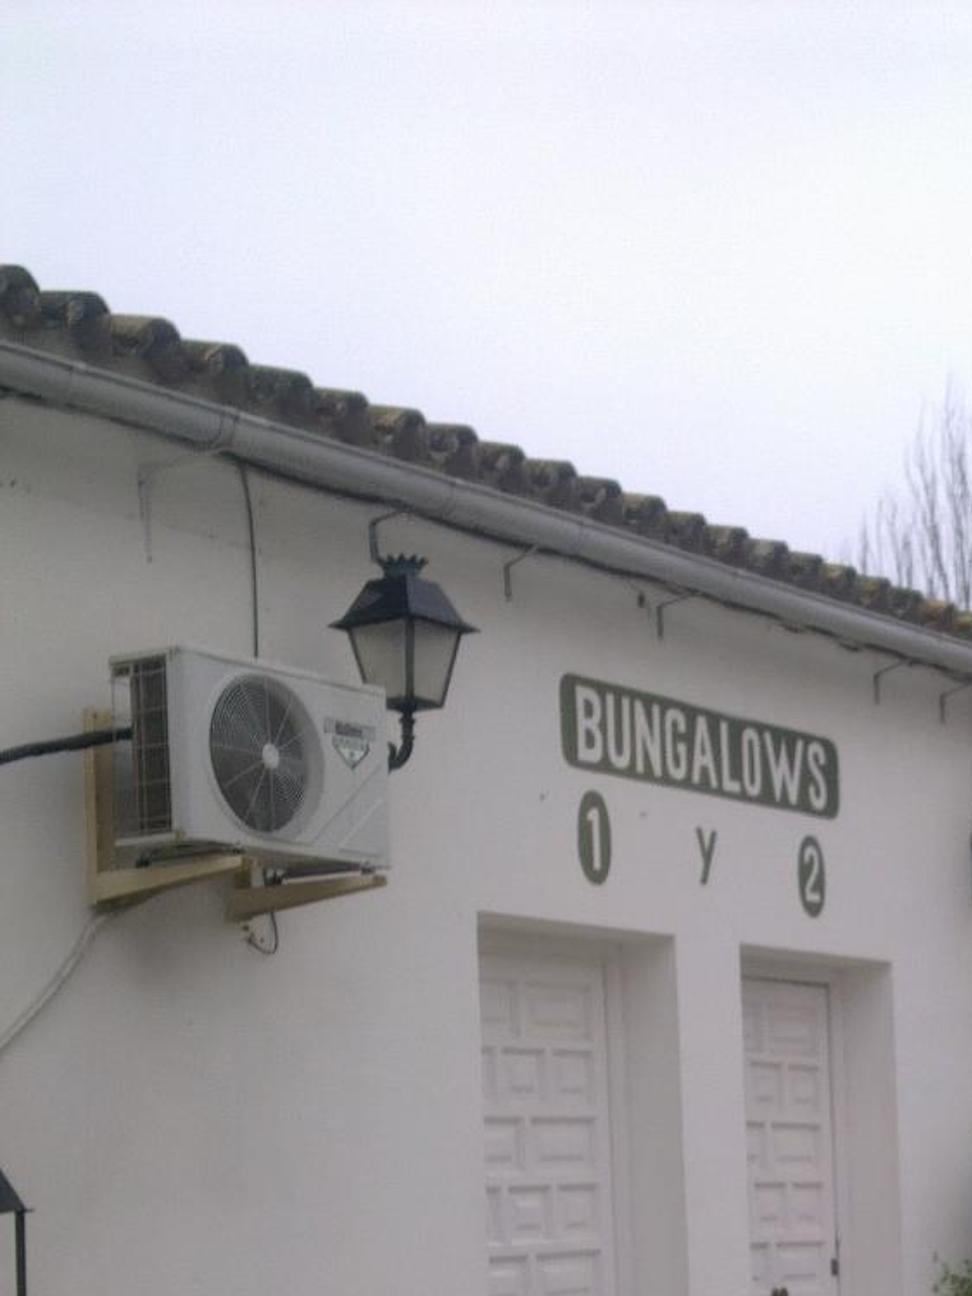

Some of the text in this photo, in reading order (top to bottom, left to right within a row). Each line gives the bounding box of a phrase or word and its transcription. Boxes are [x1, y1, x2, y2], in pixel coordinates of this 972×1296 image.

[574, 683, 829, 812] BUNGALOWS
[586, 806, 602, 872] 1
[803, 844, 821, 904] 2
